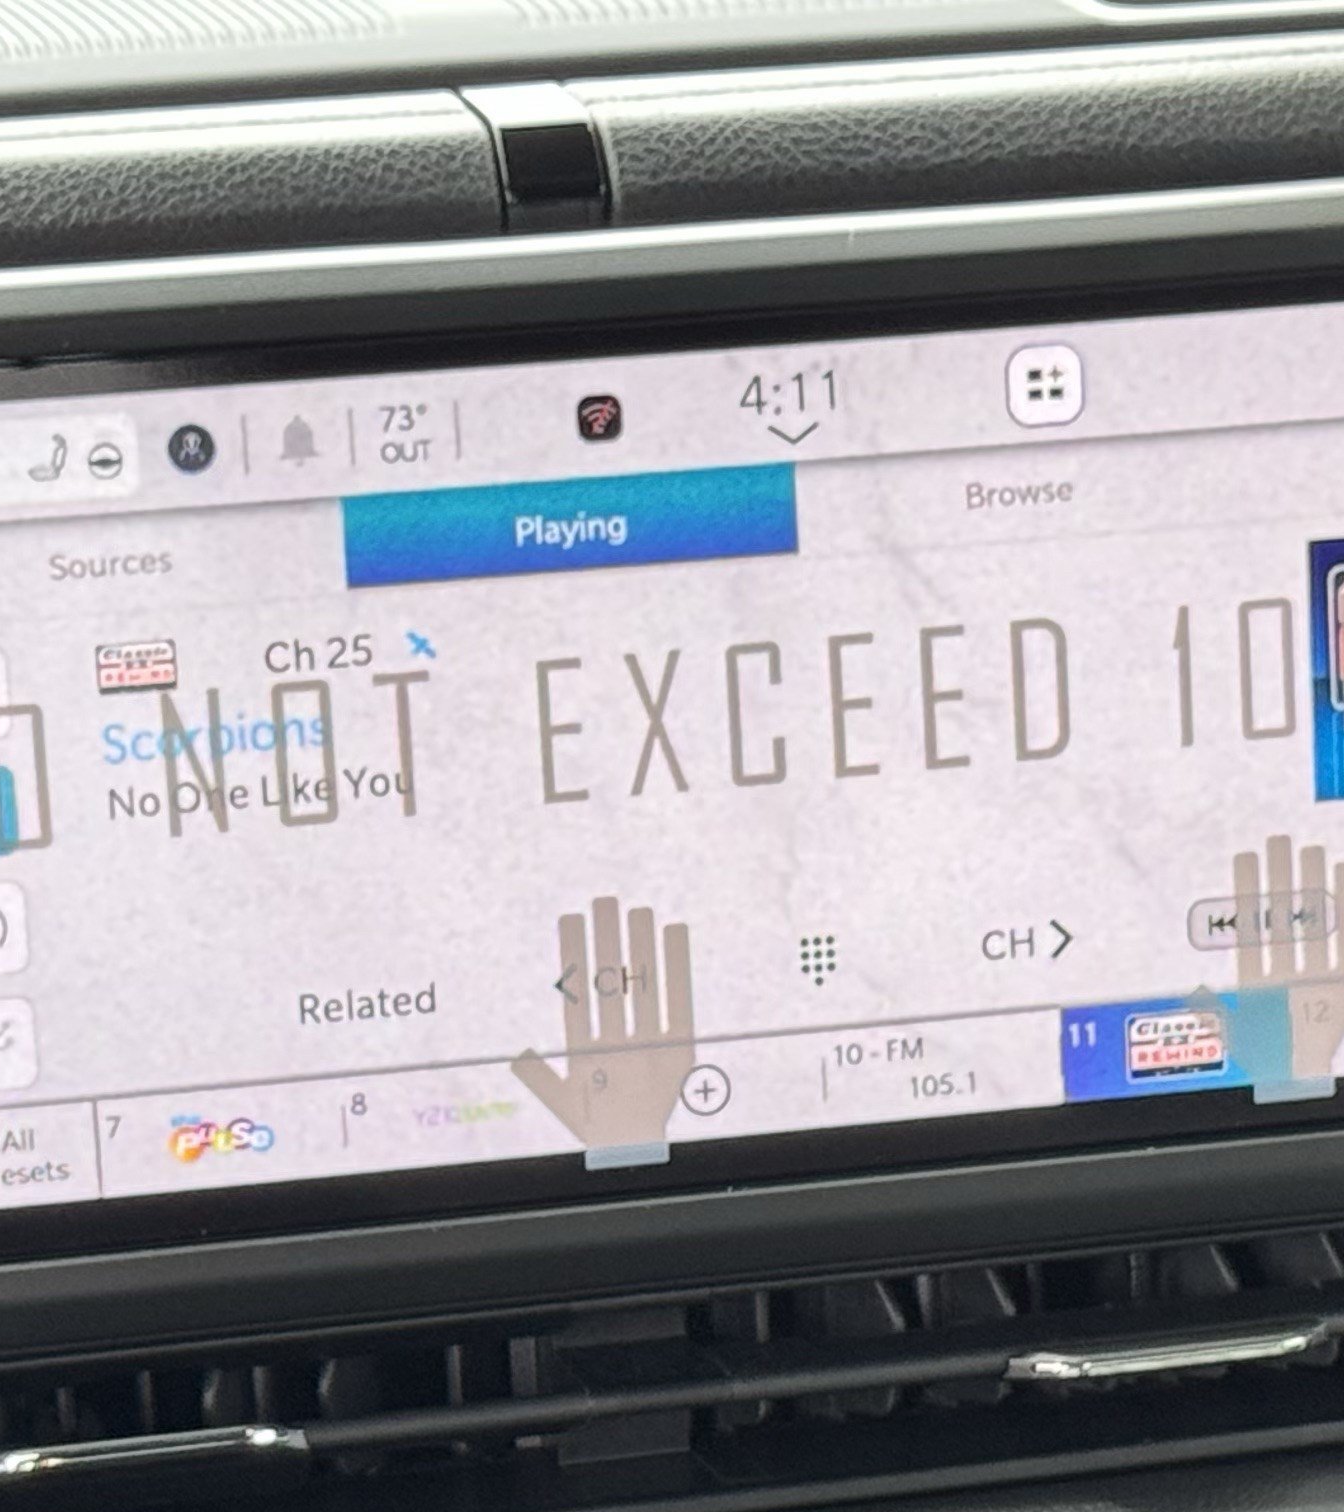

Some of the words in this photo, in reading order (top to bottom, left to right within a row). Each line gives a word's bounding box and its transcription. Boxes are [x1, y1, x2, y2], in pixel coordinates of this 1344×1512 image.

[738, 369, 839, 416] 4:11
[379, 439, 432, 464] OUT
[965, 478, 1075, 510] Browse
[514, 512, 629, 549] Playing
[49, 548, 175, 582] Sources
[264, 638, 320, 674] Ch
[326, 633, 375, 671] 25
[101, 709, 334, 766] Scorpions
[160, 669, 430, 838] NOT
[535, 616, 1071, 805] EXCEED
[107, 786, 162, 820] No
[260, 771, 335, 808] Lke
[342, 766, 414, 800] You
[982, 927, 1036, 961] CH
[593, 965, 648, 999] CH
[298, 981, 438, 1027] Related
[1301, 1001, 1331, 1024] 12
[1068, 1020, 1097, 1048] 11
[833, 1042, 864, 1067] 10
[886, 1037, 924, 1062] FM
[910, 1071, 977, 1099] 105.1
[350, 1094, 368, 1117] 8
[1, 1129, 36, 1154] All
[105, 1115, 122, 1139] 7
